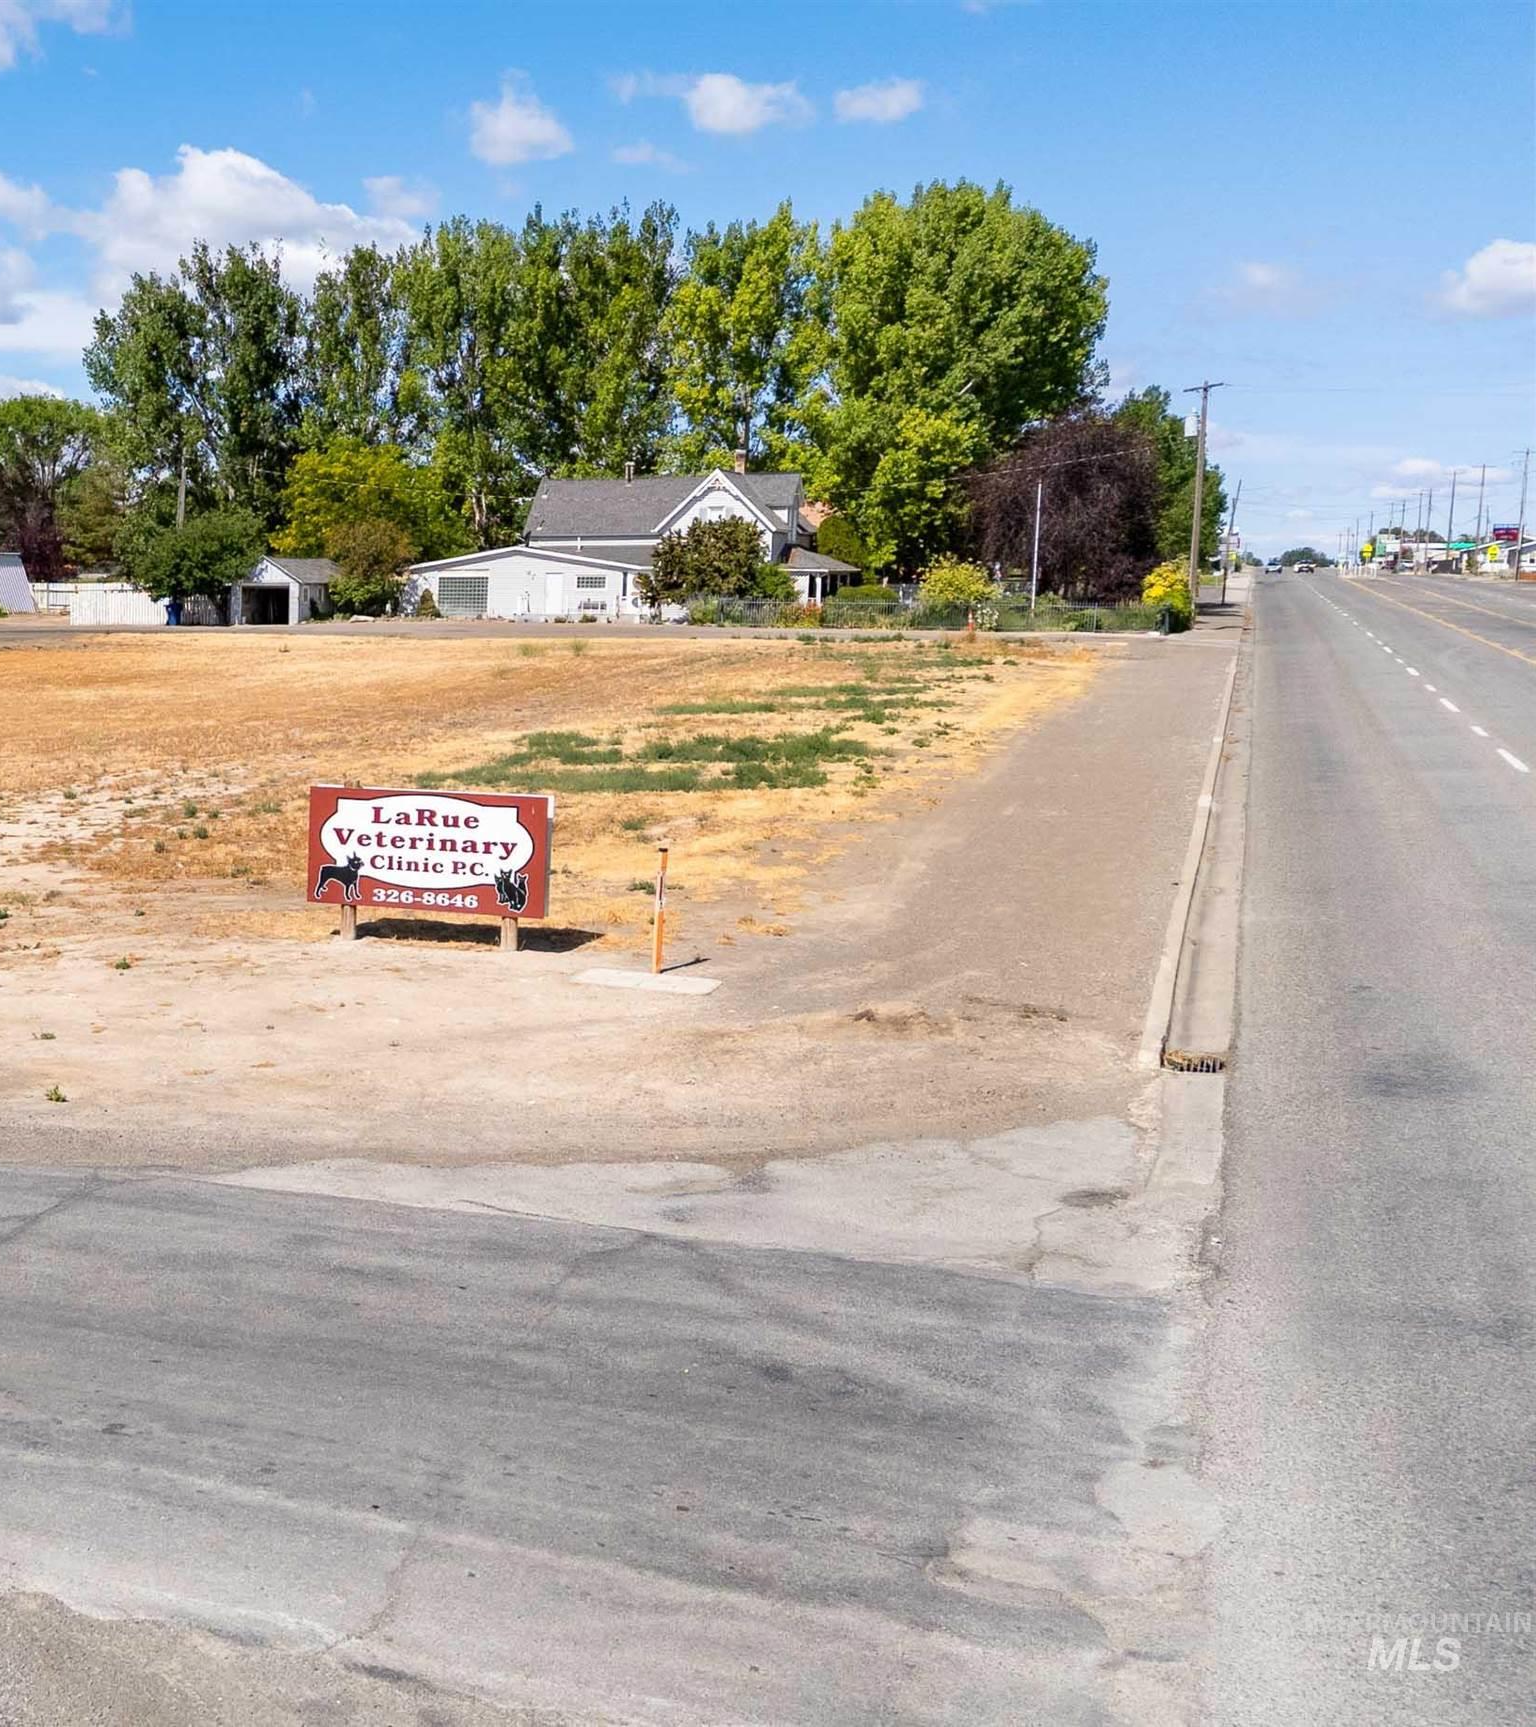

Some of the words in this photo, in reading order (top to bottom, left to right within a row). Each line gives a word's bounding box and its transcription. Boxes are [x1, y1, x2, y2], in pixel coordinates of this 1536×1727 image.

[371, 806, 480, 829] LaRue
[333, 828, 518, 860] Veterinary
[370, 855, 444, 874] Clinic
[451, 861, 489, 877] P.C.
[372, 888, 479, 908] 326-8646
